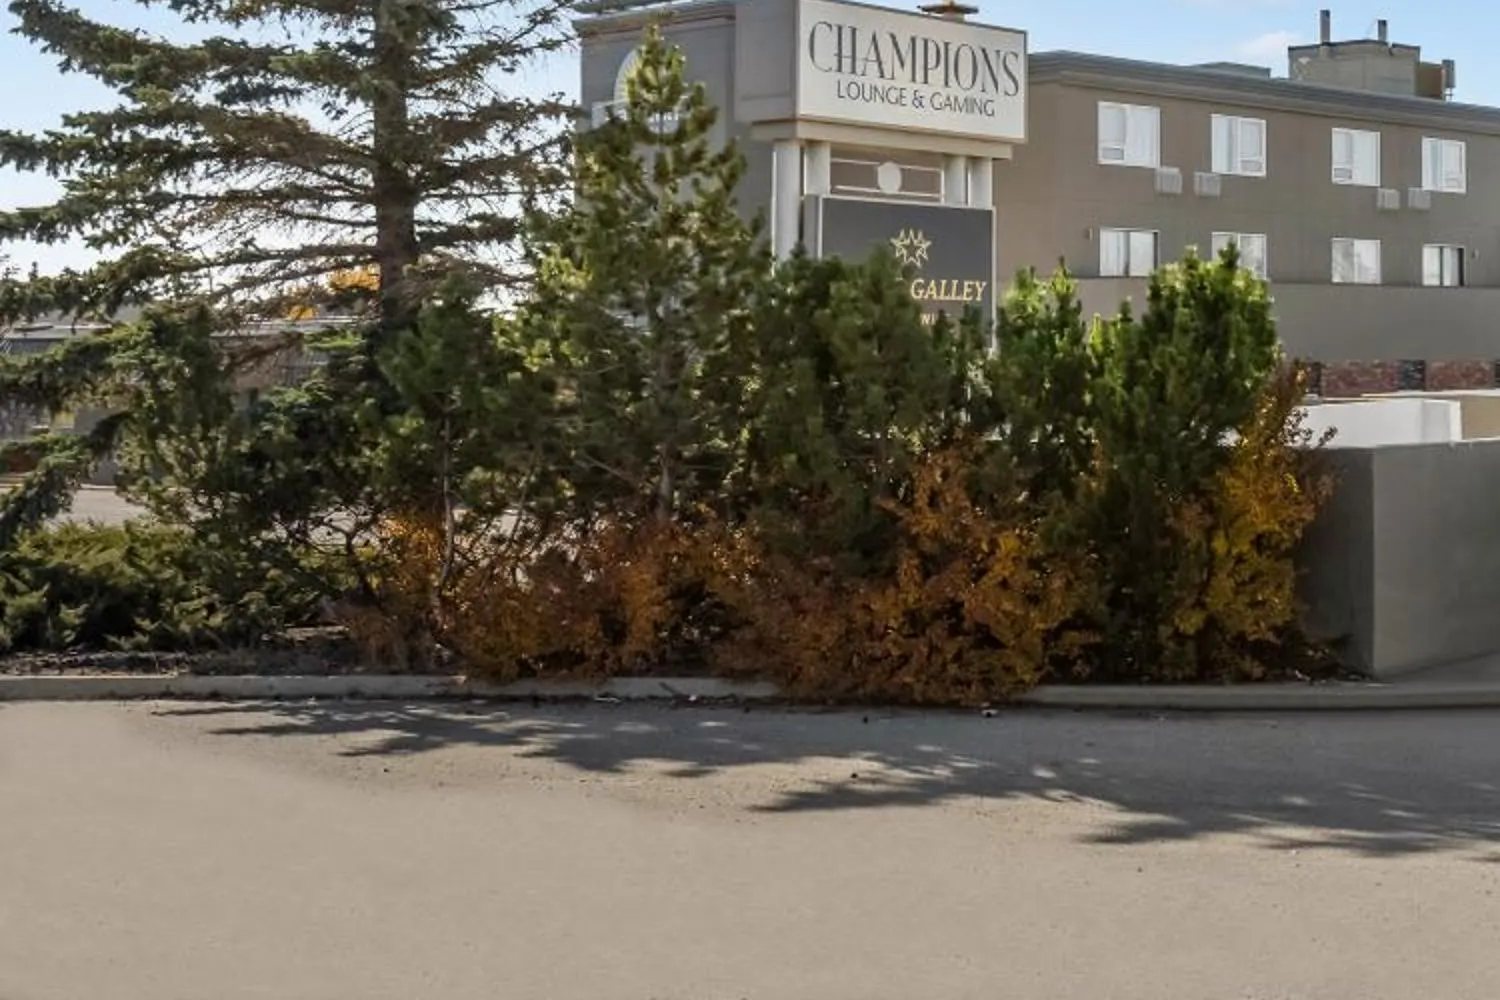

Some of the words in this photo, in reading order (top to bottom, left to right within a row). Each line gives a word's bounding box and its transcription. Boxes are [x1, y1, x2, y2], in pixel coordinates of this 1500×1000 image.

[808, 20, 1020, 97] CHAMPIONS
[836, 79, 908, 108] LOUNGE
[911, 89, 926, 109] &
[929, 91, 996, 117] GAMING
[910, 278, 987, 302] GALLEY
